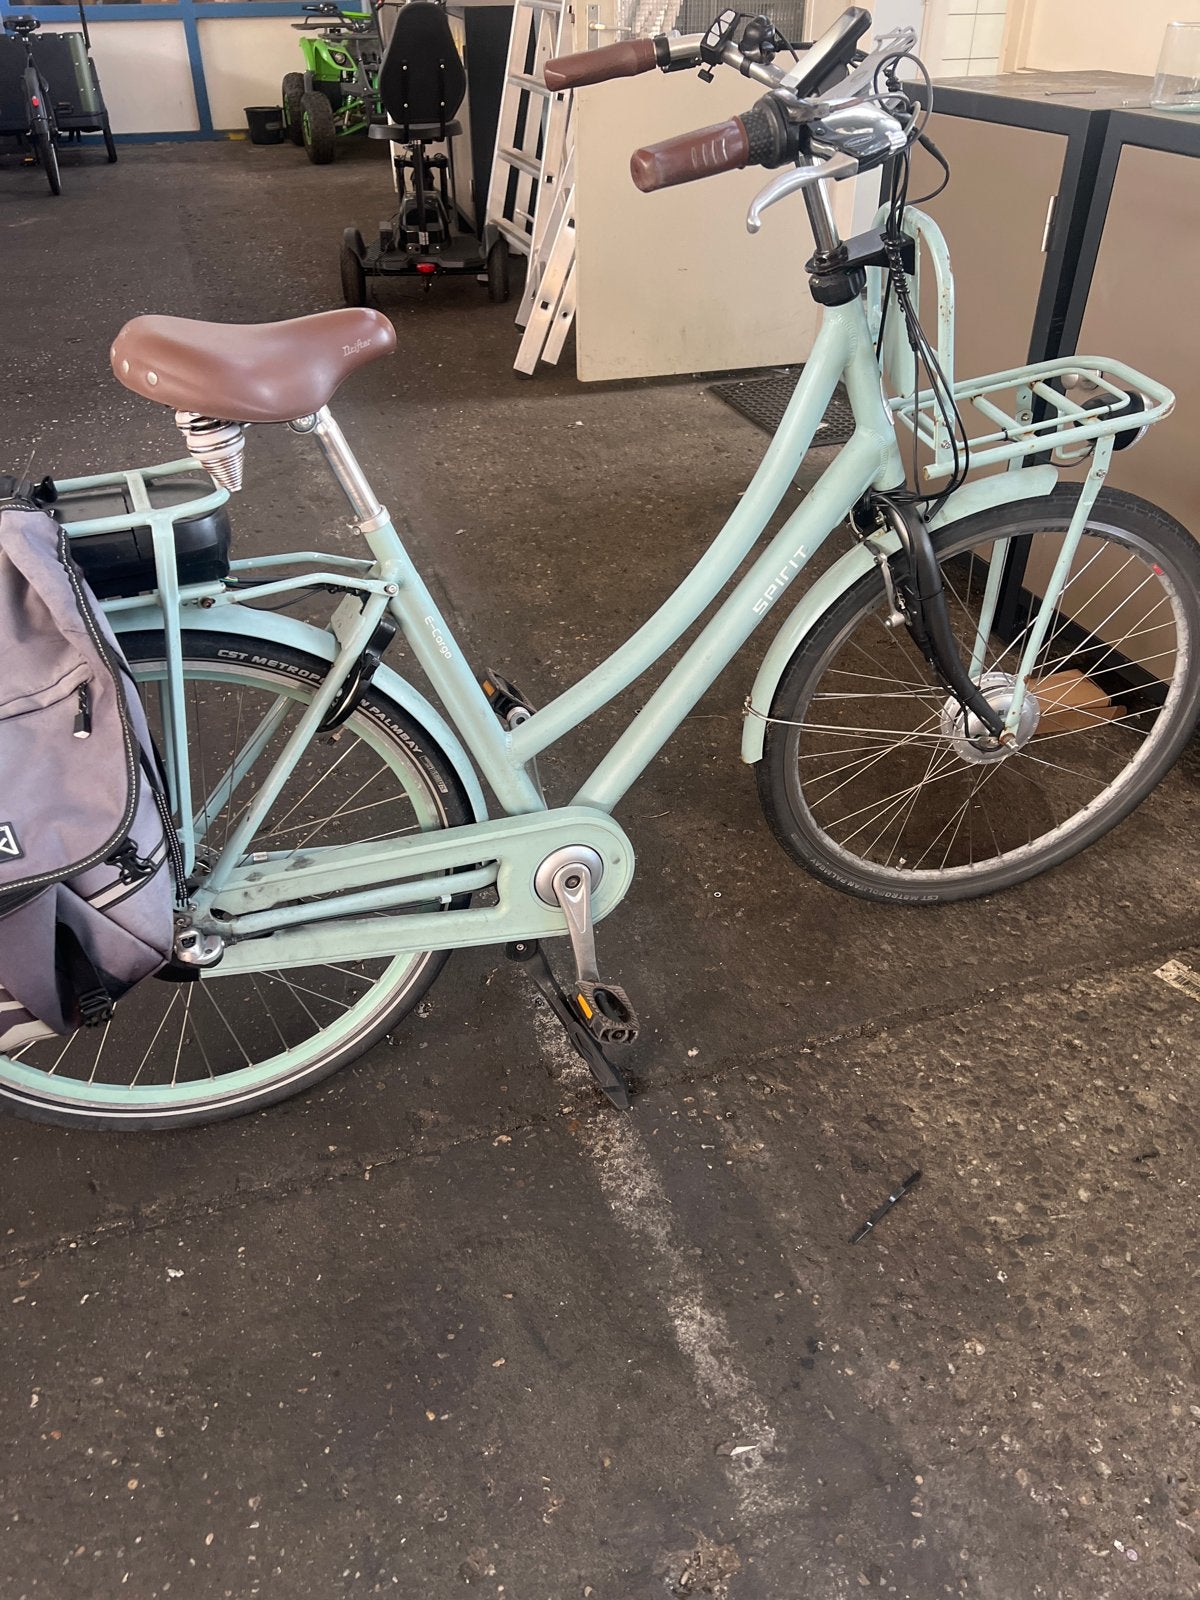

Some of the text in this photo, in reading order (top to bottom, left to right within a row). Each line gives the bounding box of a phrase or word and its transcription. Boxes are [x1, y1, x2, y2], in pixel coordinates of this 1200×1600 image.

[424, 615, 452, 659] E-Cargo
[217, 649, 249, 660] CST
[369, 706, 423, 753] PALMBAY
